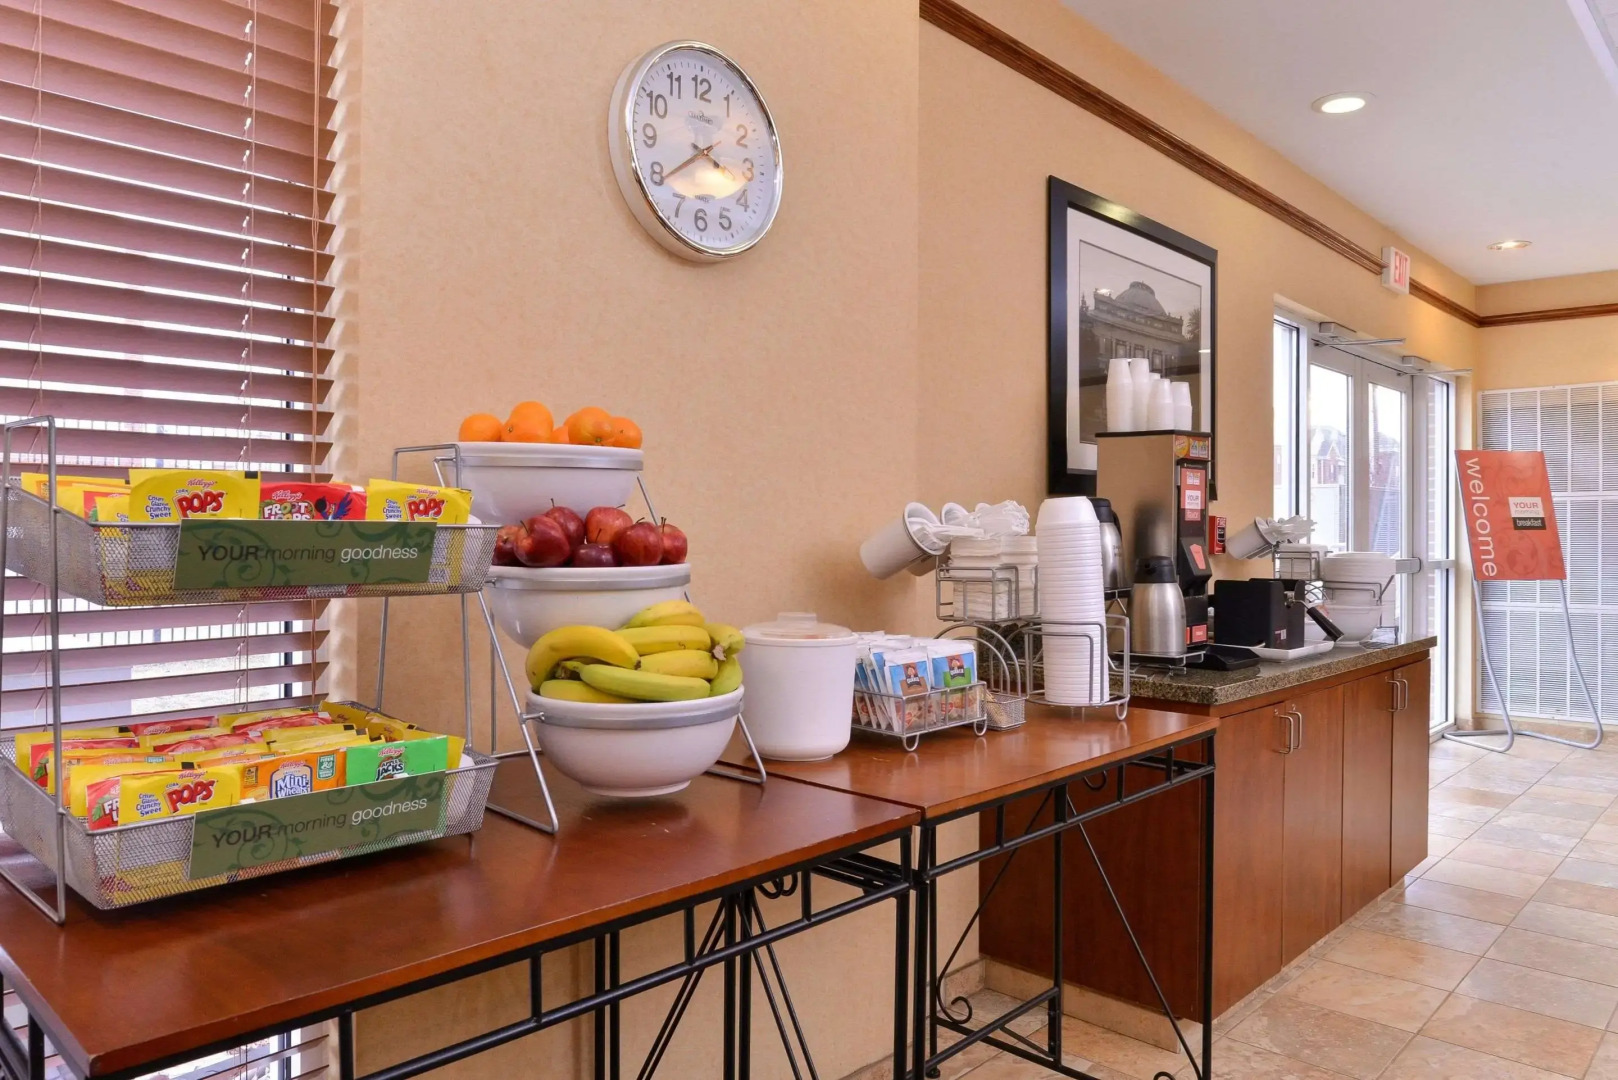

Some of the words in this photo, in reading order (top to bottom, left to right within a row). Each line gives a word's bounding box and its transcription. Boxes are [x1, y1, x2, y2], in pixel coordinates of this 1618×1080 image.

[667, 72, 682, 100] 11
[691, 74, 712, 103] 12
[646, 90, 668, 119] 10
[723, 94, 731, 118] 1
[642, 123, 657, 148] 9
[735, 124, 748, 148] 2
[650, 161, 664, 186] 8
[742, 157, 755, 182] 3
[672, 193, 686, 218] 7
[735, 189, 750, 212] 4
[693, 208, 708, 232] 6
[718, 207, 732, 231] 5
[1394, 250, 1409, 288] EXIT
[149, 511, 172, 519] Sweet
[176, 490, 225, 518] POPS
[263, 502, 309, 518] FROOT
[407, 497, 446, 521] POPS
[1465, 457, 1497, 577] welcome
[198, 545, 259, 561] YOUR
[265, 545, 336, 562] morning
[340, 544, 418, 564] goodness
[376, 763, 403, 781] JACKS
[166, 779, 216, 813] POPS
[140, 807, 162, 817] Sweet
[212, 824, 272, 849] YOUR
[278, 812, 347, 836] morning
[351, 798, 428, 826] goodness
